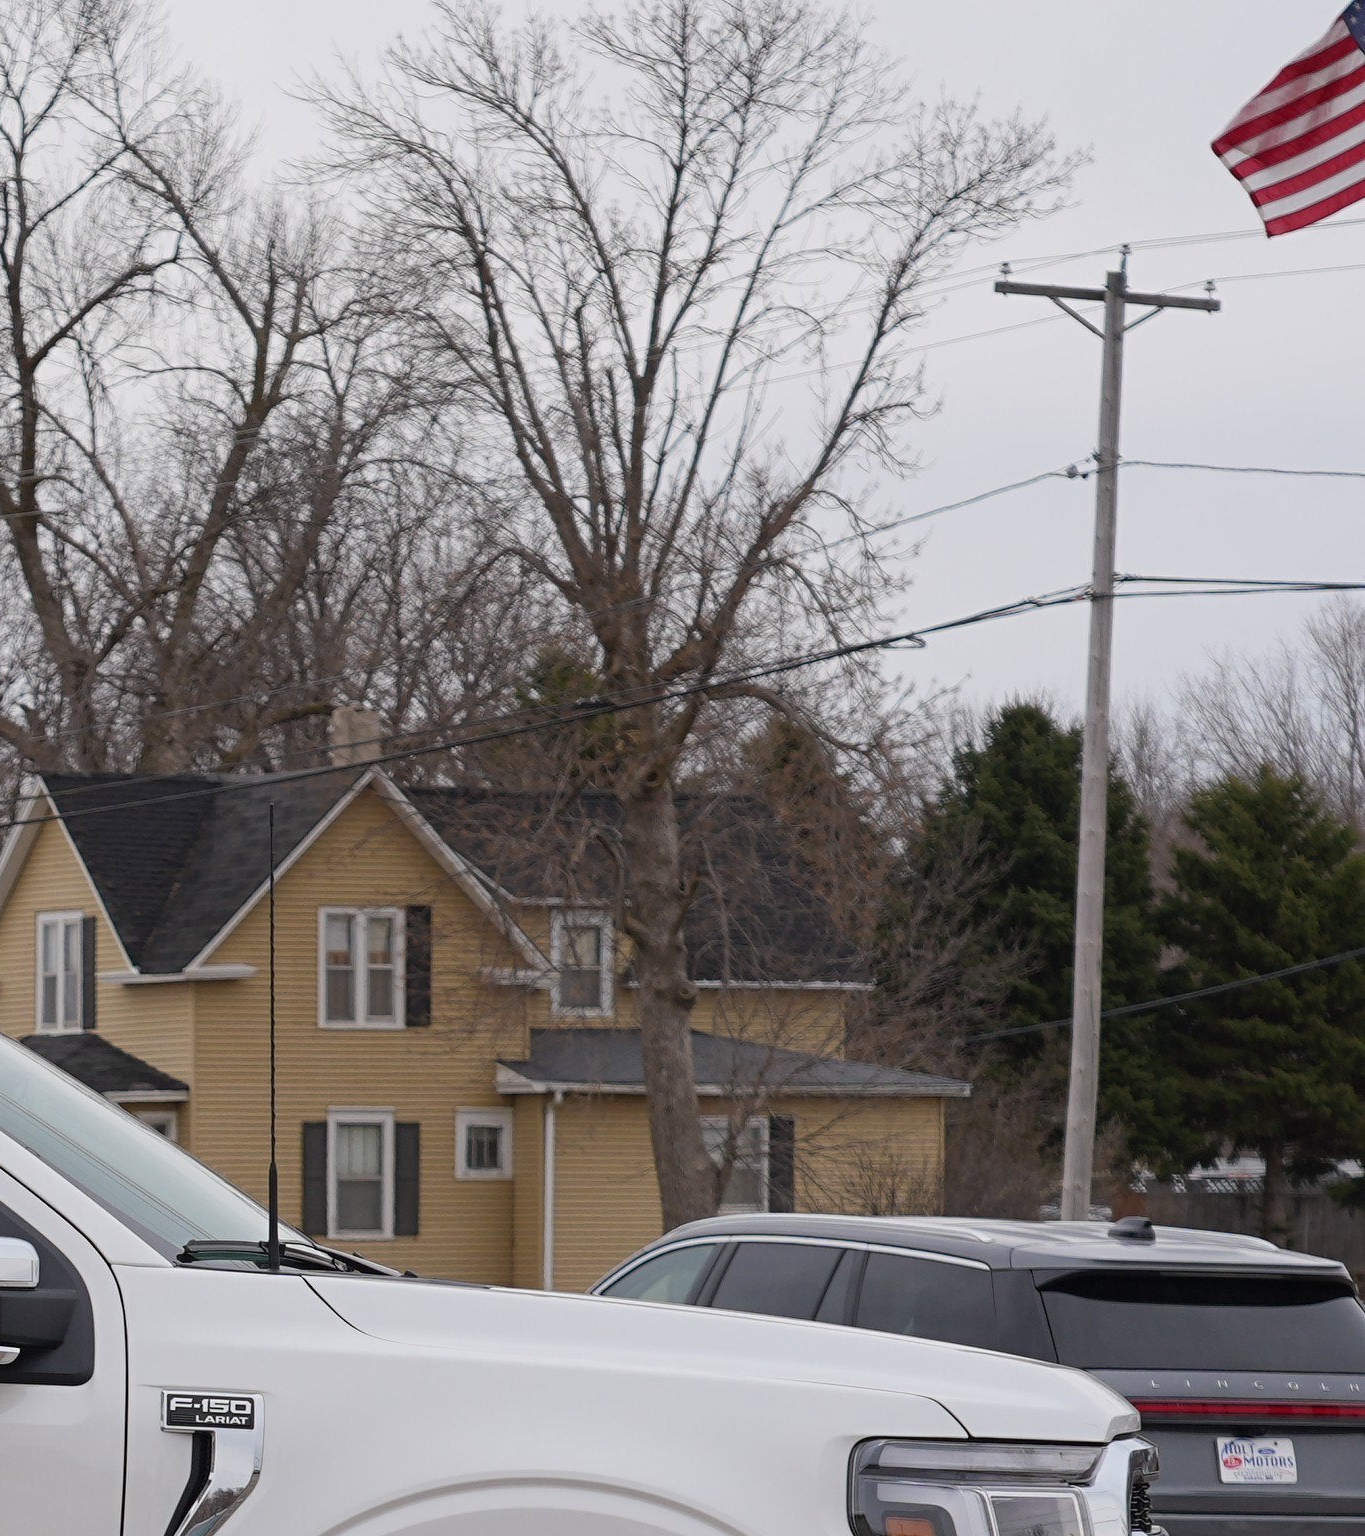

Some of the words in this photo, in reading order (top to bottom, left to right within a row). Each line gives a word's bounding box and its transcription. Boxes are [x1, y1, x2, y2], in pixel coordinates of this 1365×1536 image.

[1150, 1379, 1360, 1392] LINCOLN
[170, 1397, 252, 1415] F-150
[195, 1415, 249, 1425] LARIAT
[1244, 1456, 1294, 1468] MOTORS
